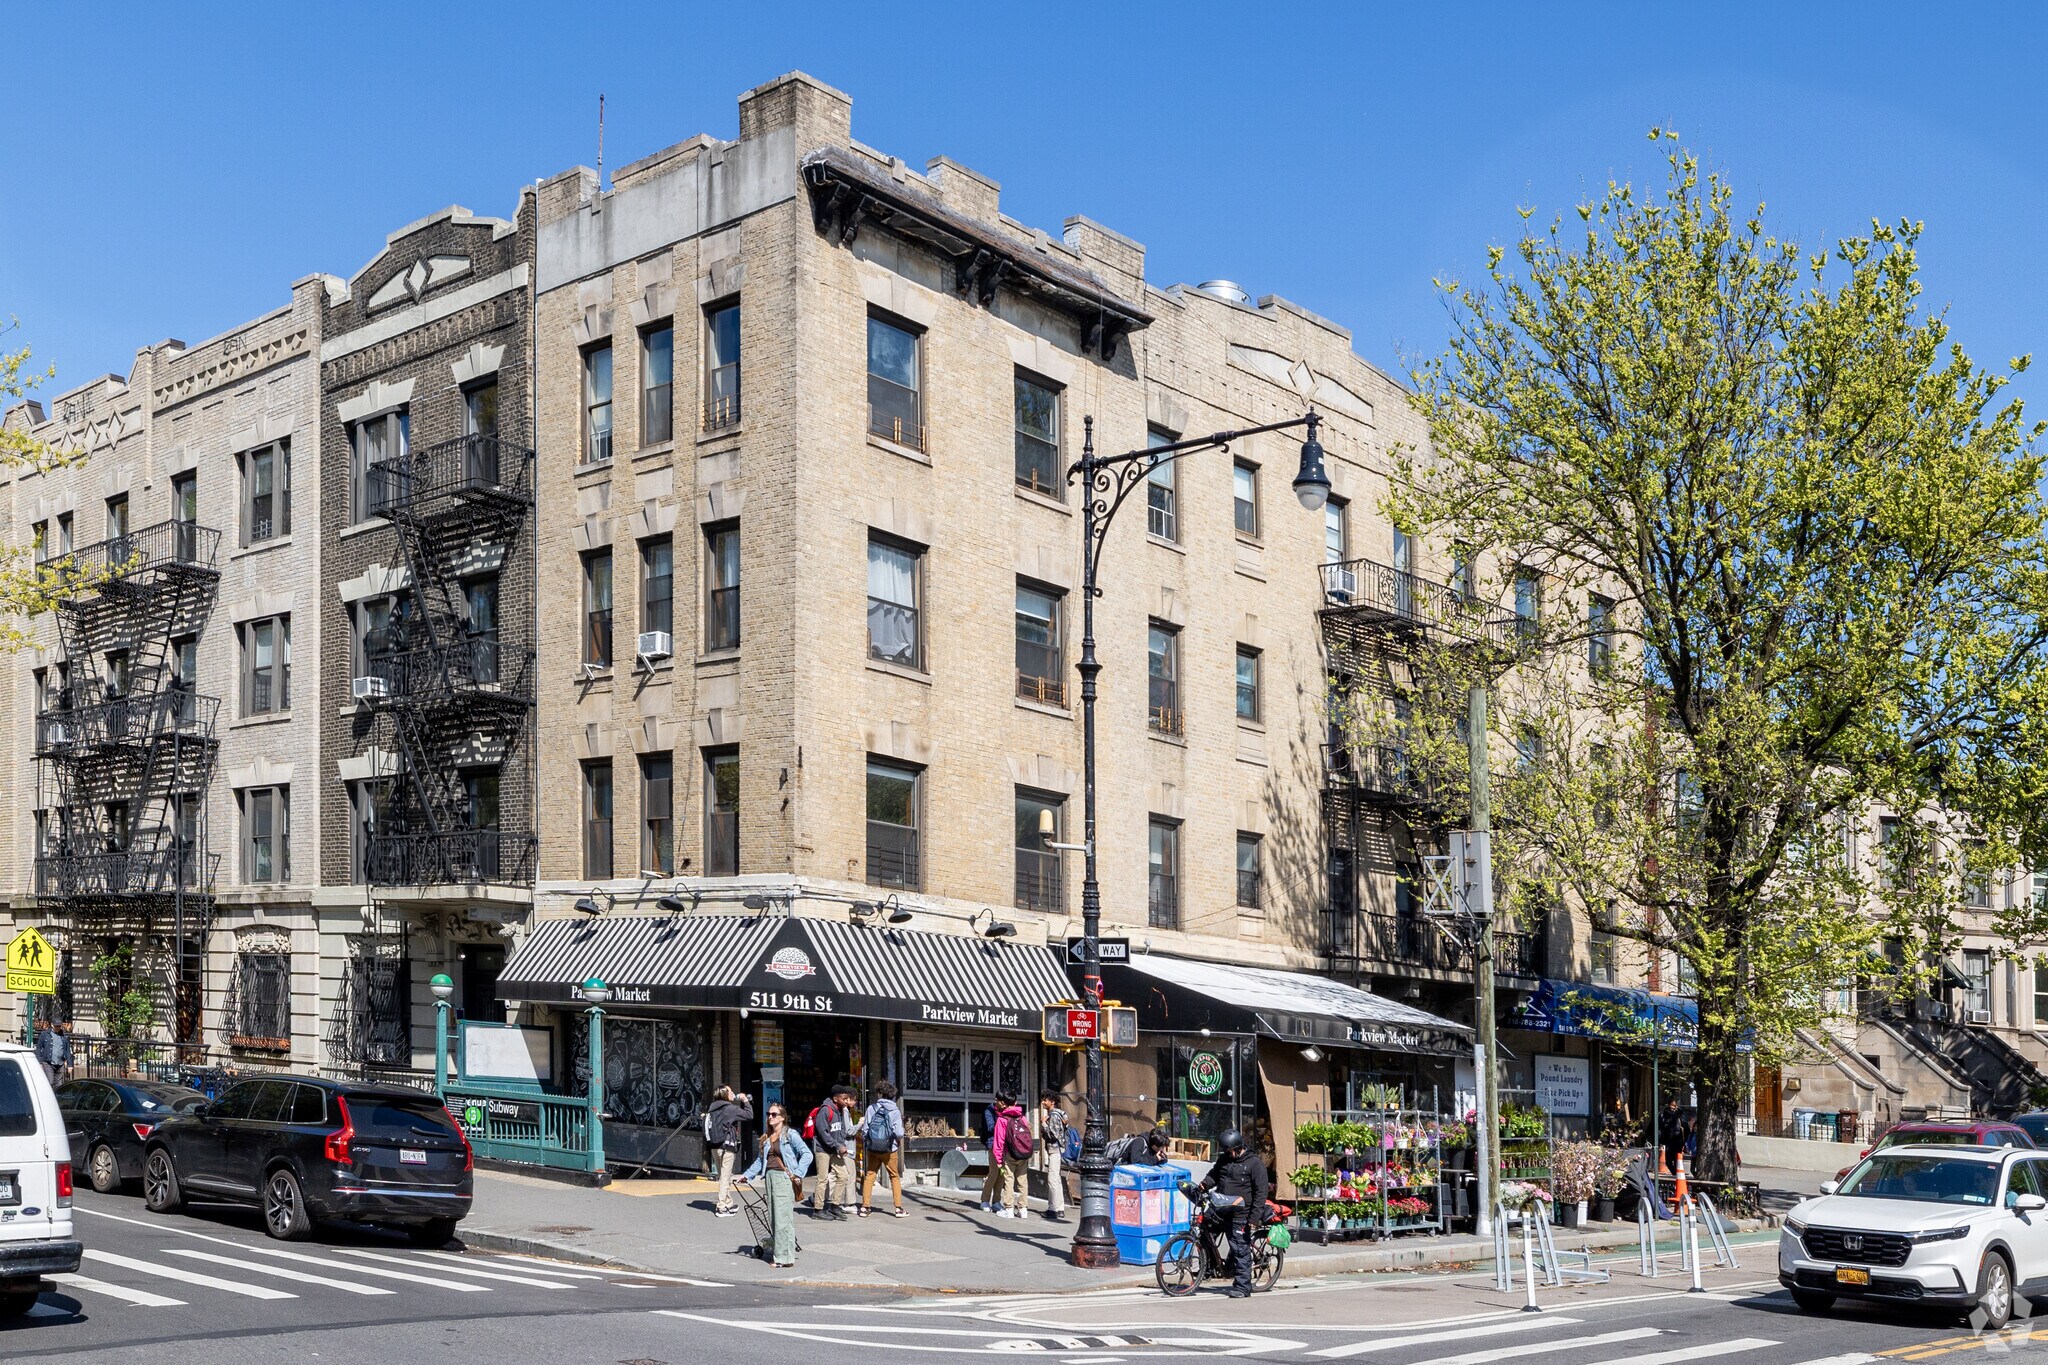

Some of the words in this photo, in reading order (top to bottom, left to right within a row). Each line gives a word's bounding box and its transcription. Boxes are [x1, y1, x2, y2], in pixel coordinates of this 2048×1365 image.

[1102, 945, 1122, 956] WAY
[10, 976, 51, 988] SCHOOL
[615, 986, 651, 1001] Market
[750, 991, 778, 1008] 511
[782, 993, 810, 1010] 9th
[814, 995, 833, 1012] St
[921, 1004, 975, 1023] Parkview
[977, 1009, 1019, 1026] Market
[1072, 1020, 1092, 1028] WRONG
[1346, 1026, 1386, 1043] Parkview
[1388, 1031, 1419, 1046] Market
[1553, 1064, 1562, 1073] We
[1563, 1065, 1571, 1073] Do
[1540, 1073, 1559, 1082] Pound
[1560, 1074, 1583, 1086] Laundry
[1197, 1083, 1217, 1094] SHOP
[1558, 1089, 1571, 1097] Pick
[1572, 1089, 1580, 1099] Up
[488, 1100, 519, 1117] Subway
[1553, 1098, 1577, 1109] Delivery
[390, 1137, 439, 1145] VOLVO
